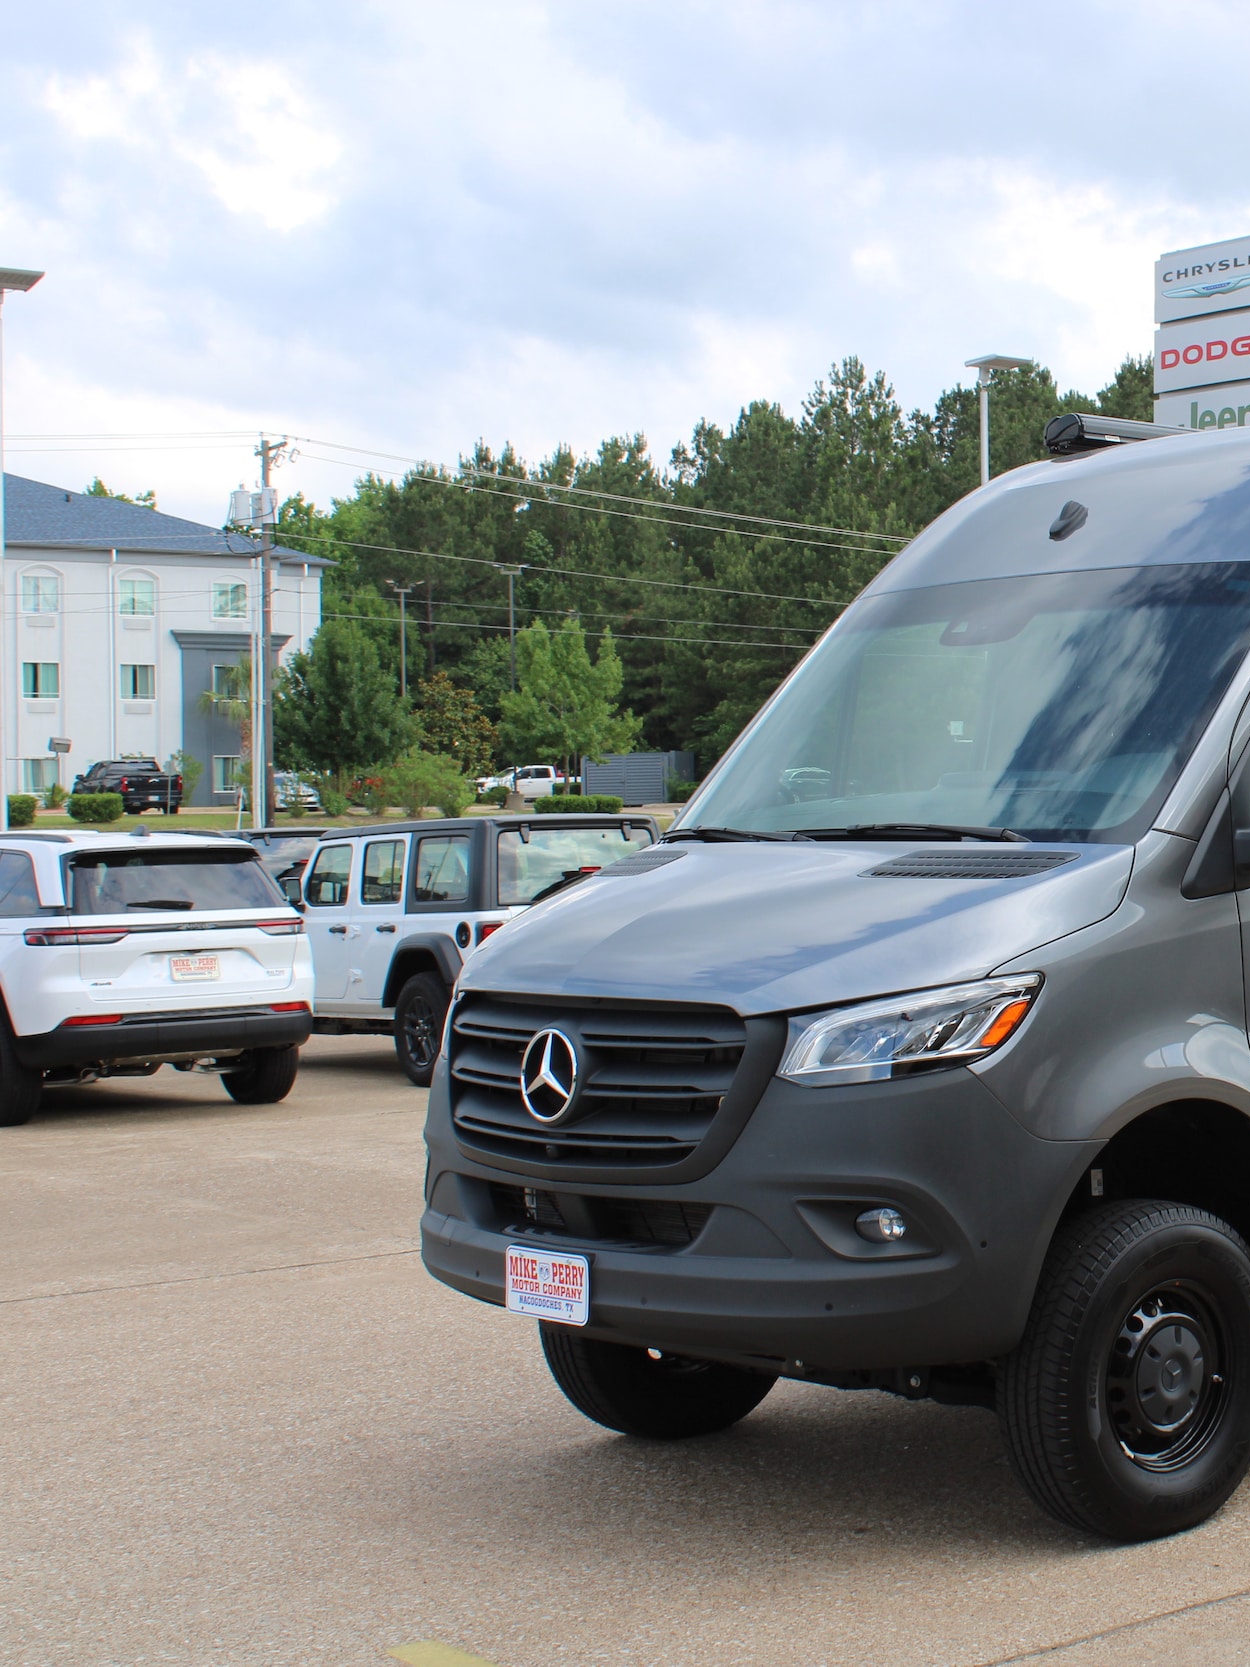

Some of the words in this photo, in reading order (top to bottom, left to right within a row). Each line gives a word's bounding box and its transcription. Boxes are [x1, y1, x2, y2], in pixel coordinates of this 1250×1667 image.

[509, 1256, 538, 1280] MIKE
[551, 1263, 584, 1287] PERRY
[512, 1278, 540, 1293] MOTOR
[543, 1283, 582, 1300] COMPANY
[565, 1303, 574, 1312] TX
